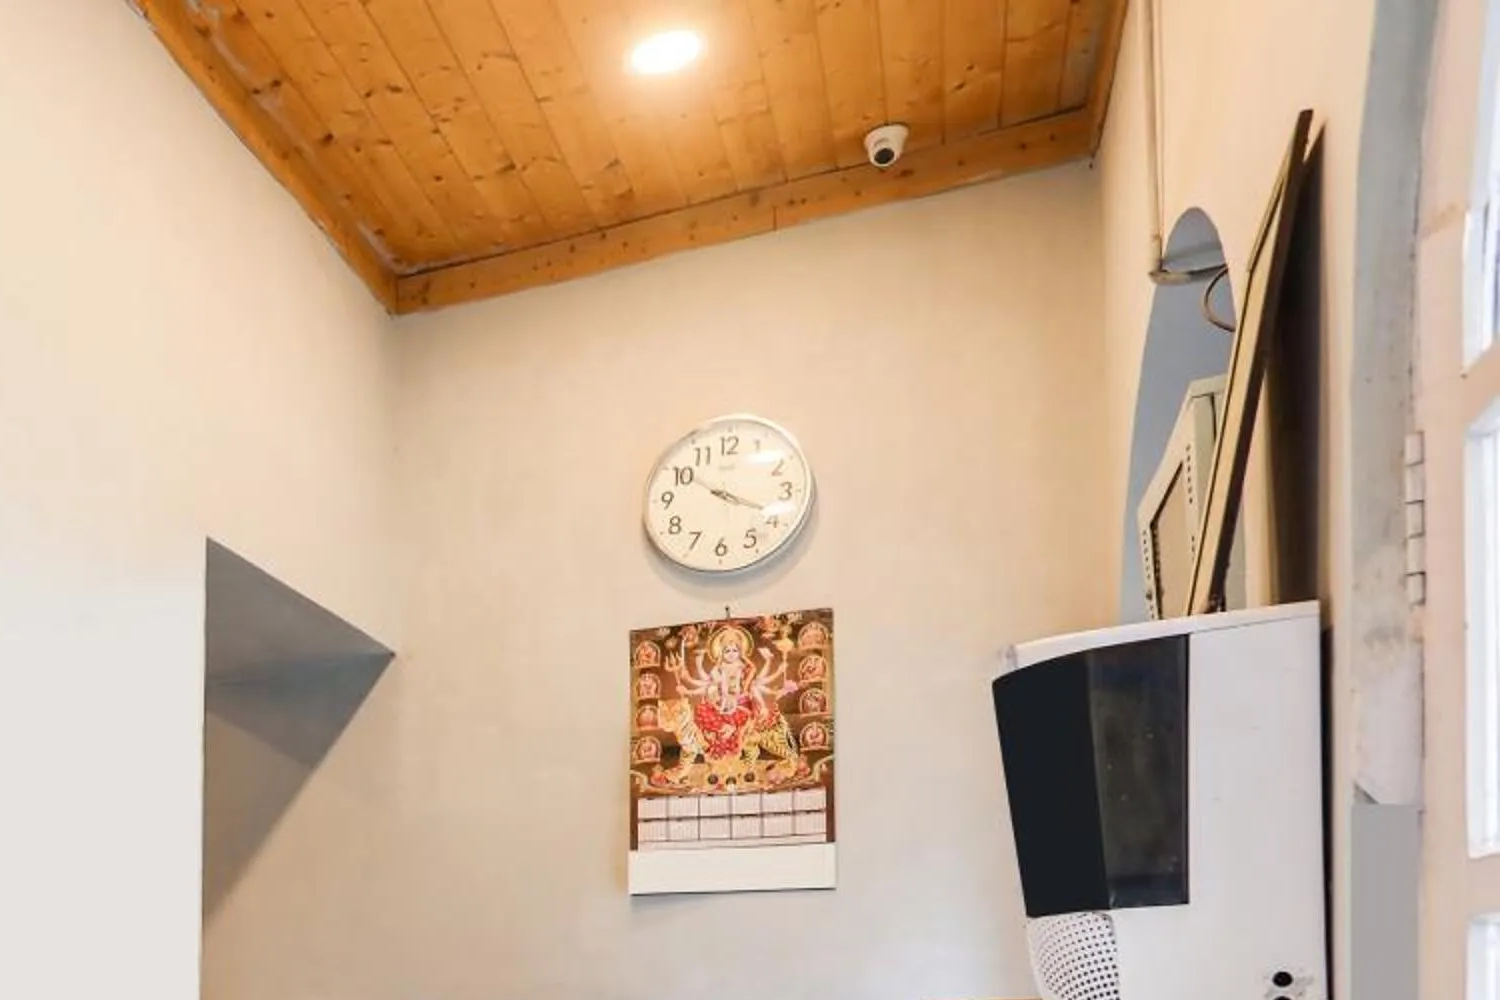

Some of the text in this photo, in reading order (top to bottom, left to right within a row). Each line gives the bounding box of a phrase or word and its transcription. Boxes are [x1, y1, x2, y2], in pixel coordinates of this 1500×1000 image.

[694, 446, 712, 467] 11
[719, 435, 740, 457] 12
[672, 466, 695, 487] 10
[771, 457, 786, 477] 2
[660, 490, 675, 511] 9
[778, 481, 793, 502] 3
[667, 515, 682, 536] 8
[765, 514, 781, 529] 4
[687, 530, 702, 551] 7
[714, 536, 728, 558] 6
[743, 528, 758, 550] 5
